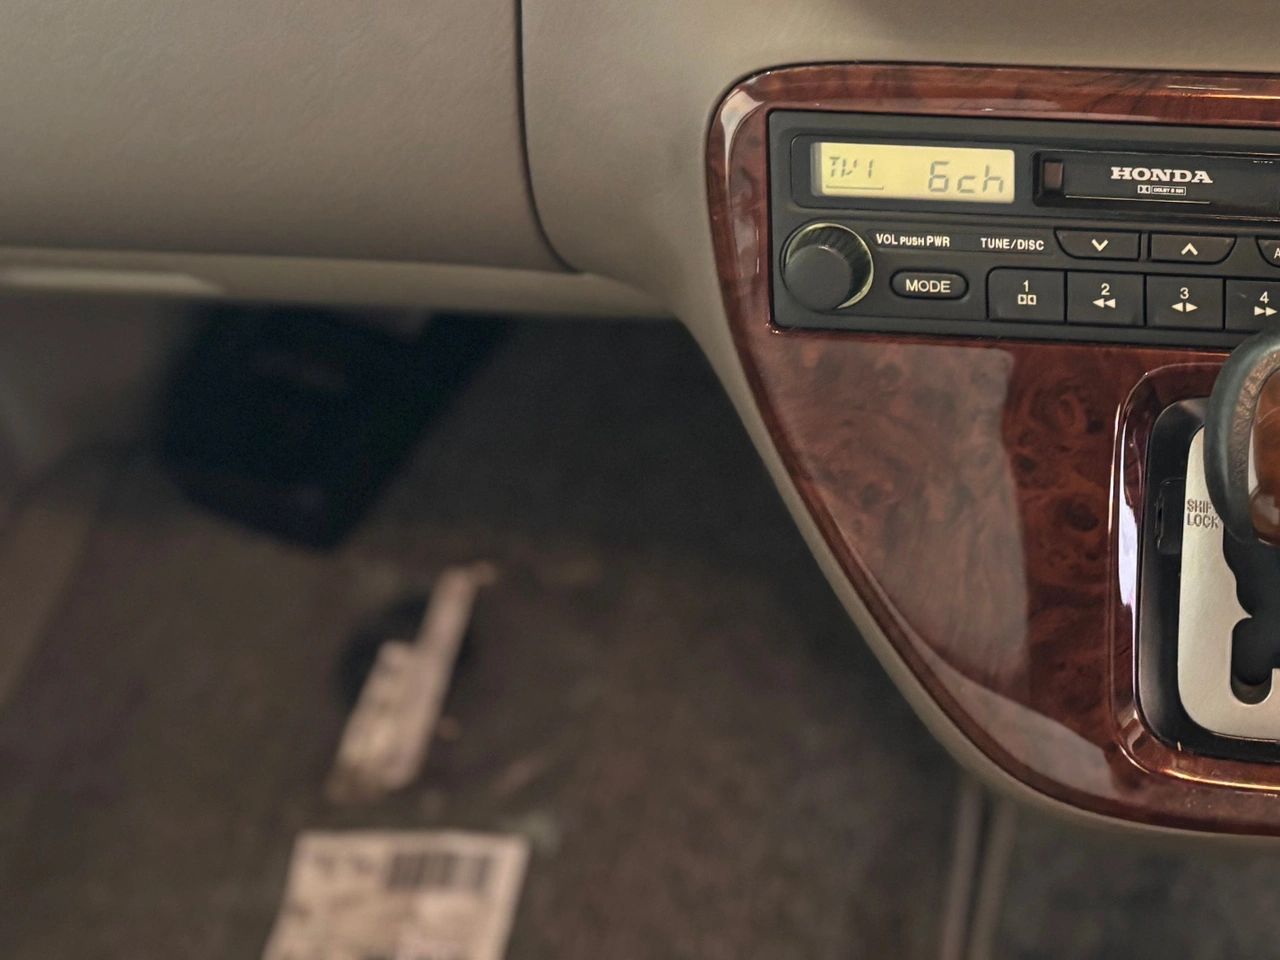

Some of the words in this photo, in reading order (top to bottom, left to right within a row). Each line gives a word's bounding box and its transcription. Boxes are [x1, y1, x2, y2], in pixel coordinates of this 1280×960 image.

[928, 160, 1004, 193] 6ch
[1110, 167, 1213, 184] HONDA
[876, 234, 898, 245] VOL
[900, 236, 924, 246] PUSH
[926, 236, 950, 247] PWR
[981, 237, 1044, 251] TUNE/DISC
[906, 279, 951, 292] MODE
[1023, 280, 1029, 292] 1
[1101, 283, 1110, 295] 2
[1180, 287, 1189, 300] 3
[1259, 292, 1269, 304] 4
[1187, 499, 1213, 514] SHIF
[1187, 513, 1219, 528] LOCK
